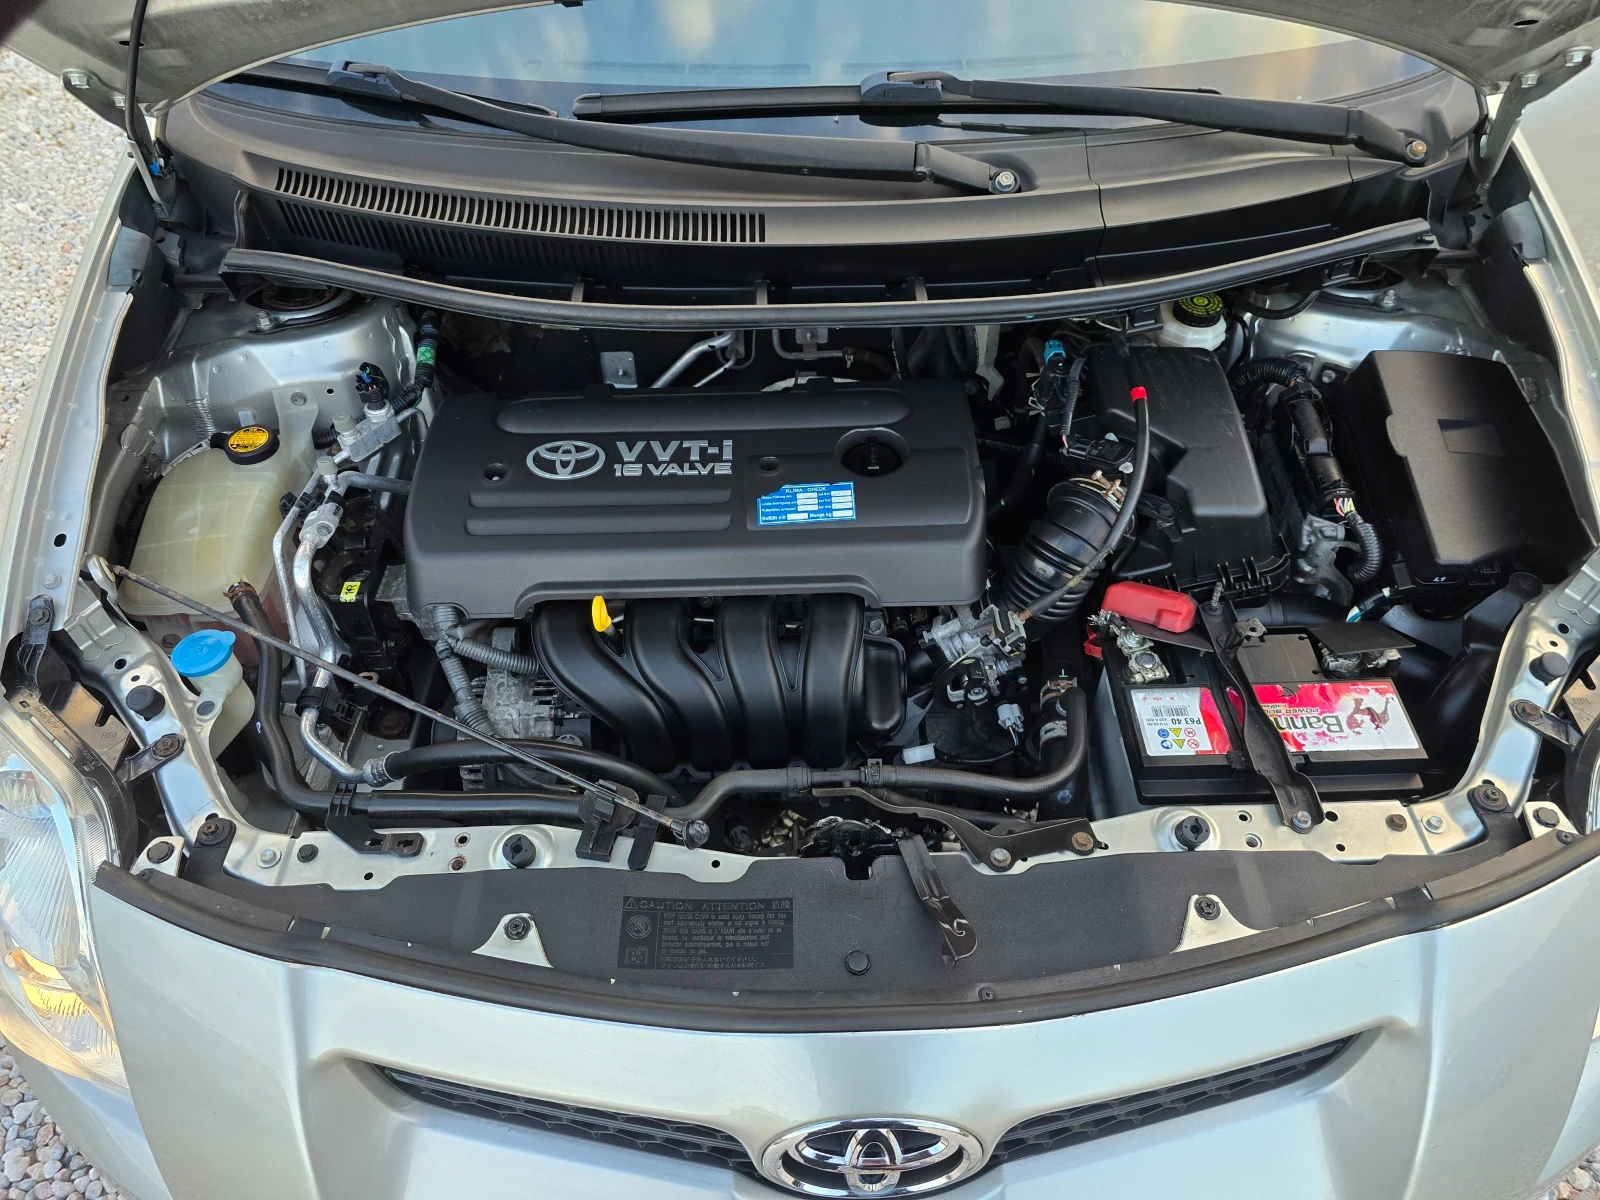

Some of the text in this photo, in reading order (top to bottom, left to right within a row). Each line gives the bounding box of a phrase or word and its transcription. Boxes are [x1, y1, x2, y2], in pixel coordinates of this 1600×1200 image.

[616, 440, 733, 462] VVT-i
[614, 463, 732, 477] 16 VALVE
[1171, 717, 1202, 725] P63 40
[640, 900, 766, 911] CAUTION ATTENTION
